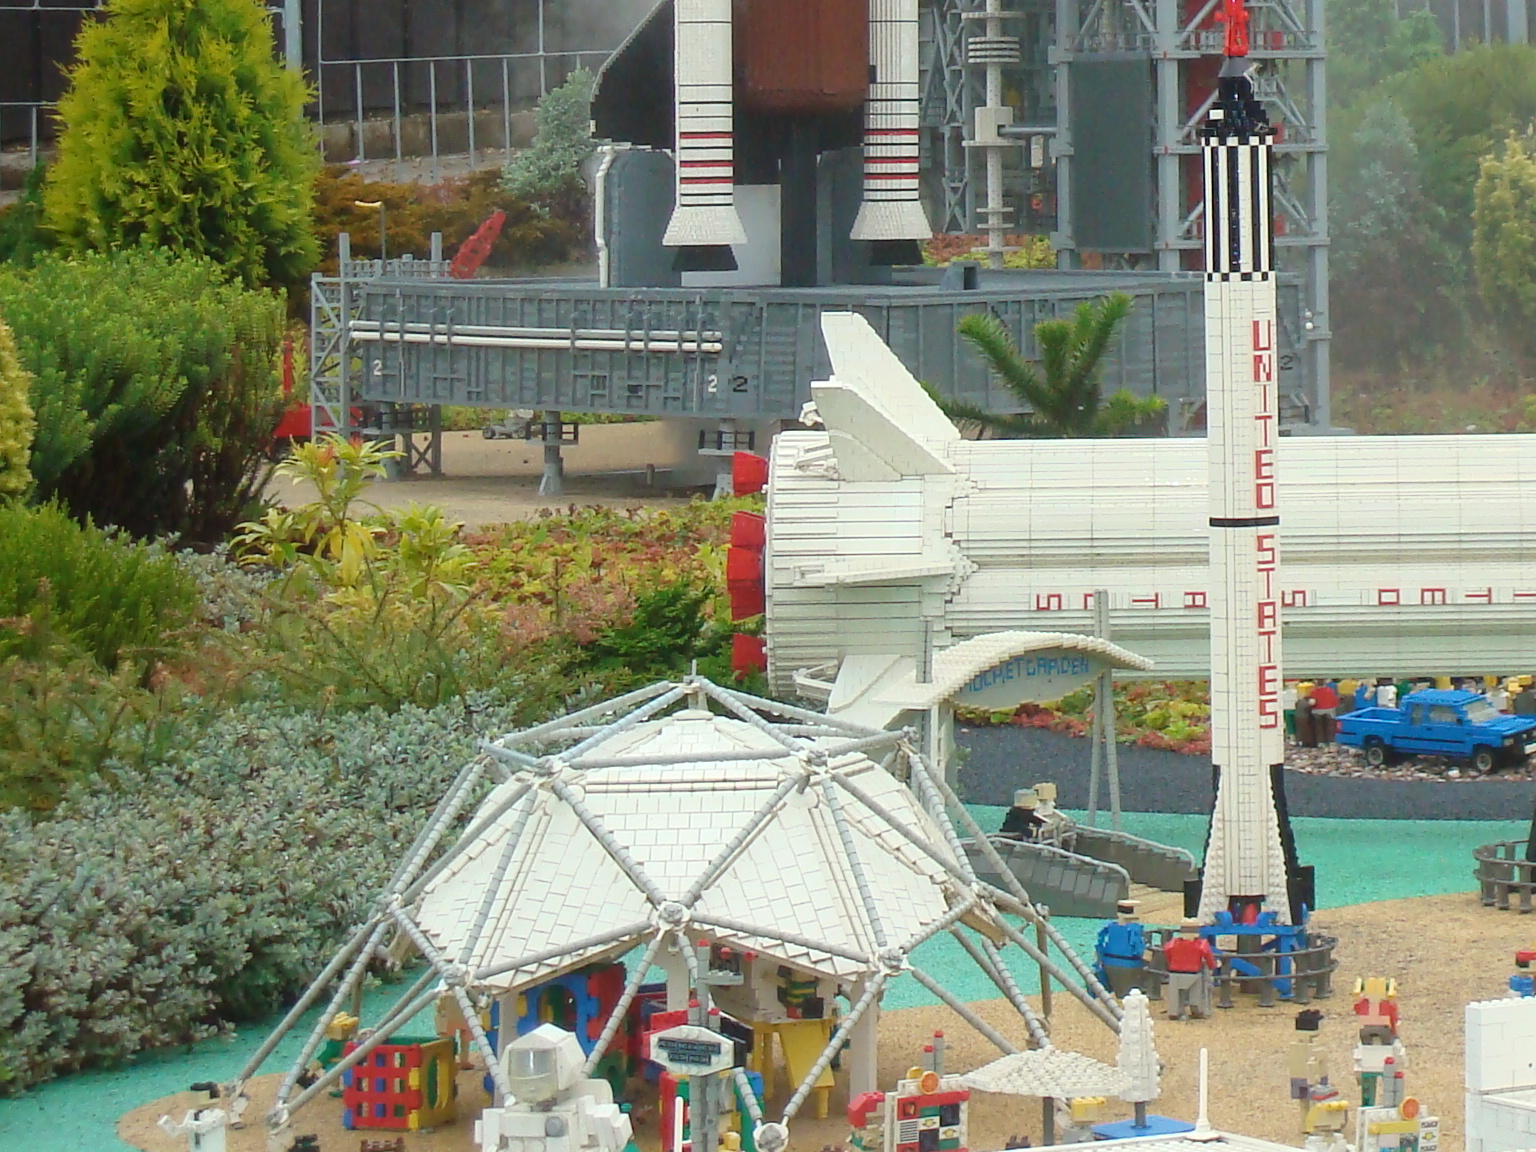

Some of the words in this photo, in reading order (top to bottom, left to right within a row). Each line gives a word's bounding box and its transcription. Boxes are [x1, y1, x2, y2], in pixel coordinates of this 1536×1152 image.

[373, 358, 382, 376] 2
[707, 374, 718, 393] 2
[732, 375, 748, 393] 2
[1252, 320, 1275, 509] UNITED
[1257, 535, 1278, 729] STATES
[962, 656, 1025, 693] OCKET
